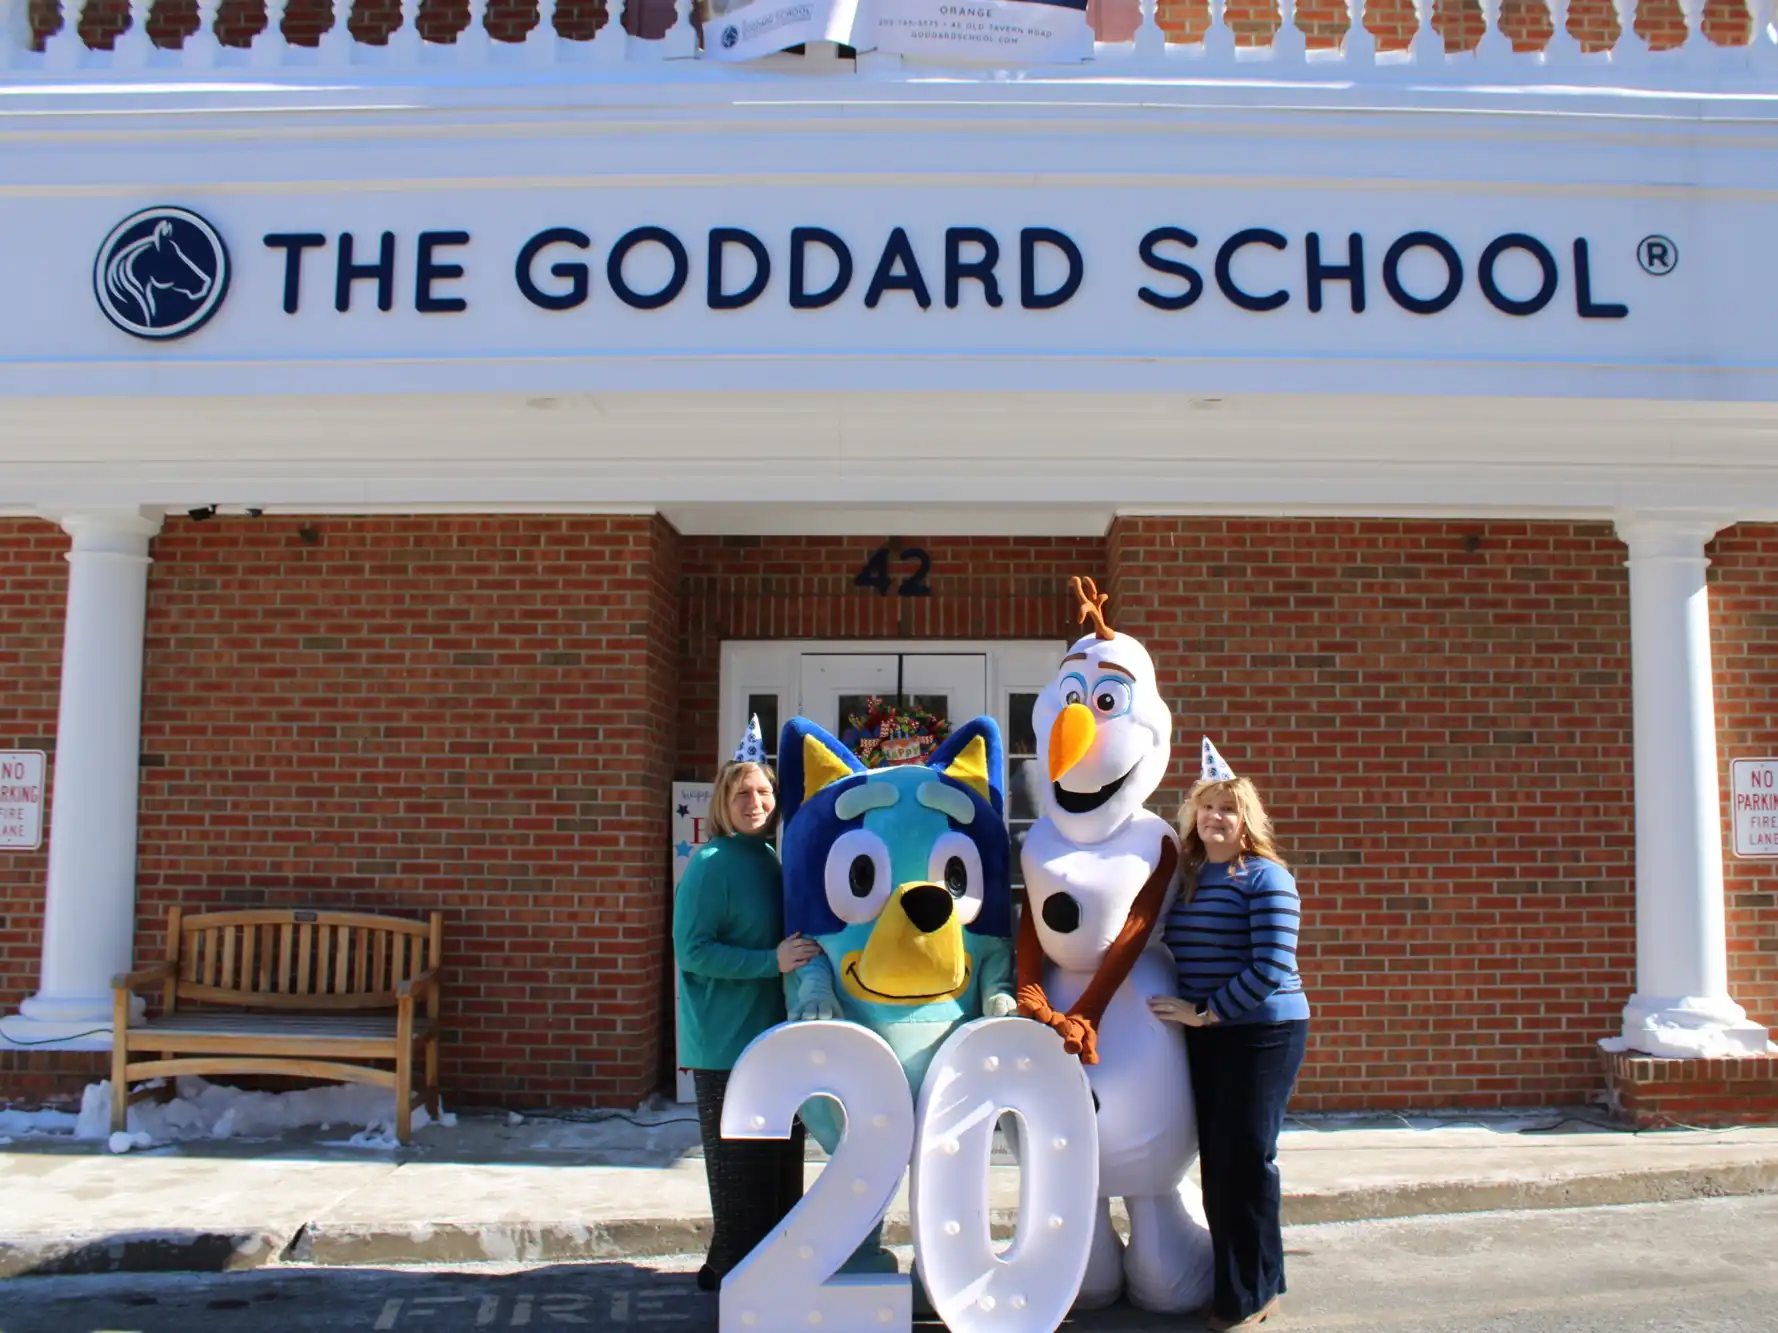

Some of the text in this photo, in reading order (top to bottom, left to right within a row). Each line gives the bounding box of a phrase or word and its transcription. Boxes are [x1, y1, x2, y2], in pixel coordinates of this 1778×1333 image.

[940, 6, 993, 18] ORANGE
[966, 23, 985, 31] OLD
[989, 23, 1024, 35] TAVERN
[1028, 28, 1053, 39] ROAD
[263, 231, 470, 314] THE
[515, 226, 1083, 310] GODDARD
[1138, 227, 1629, 318] SCHOOL
[854, 548, 931, 597] 42
[884, 745, 920, 759] HAPPY
[2, 762, 24, 780] NO
[1751, 770, 1773, 788] NO
[0, 785, 38, 803] RKING
[682, 788, 711, 804] happ
[1737, 793, 1778, 811] PARKIN
[0, 824, 24, 837] ANE
[1750, 815, 1778, 828] FIRE
[1749, 833, 1778, 846] LANE
[720, 1016, 1100, 1333] 20
[373, 1289, 690, 1331] FIRE
